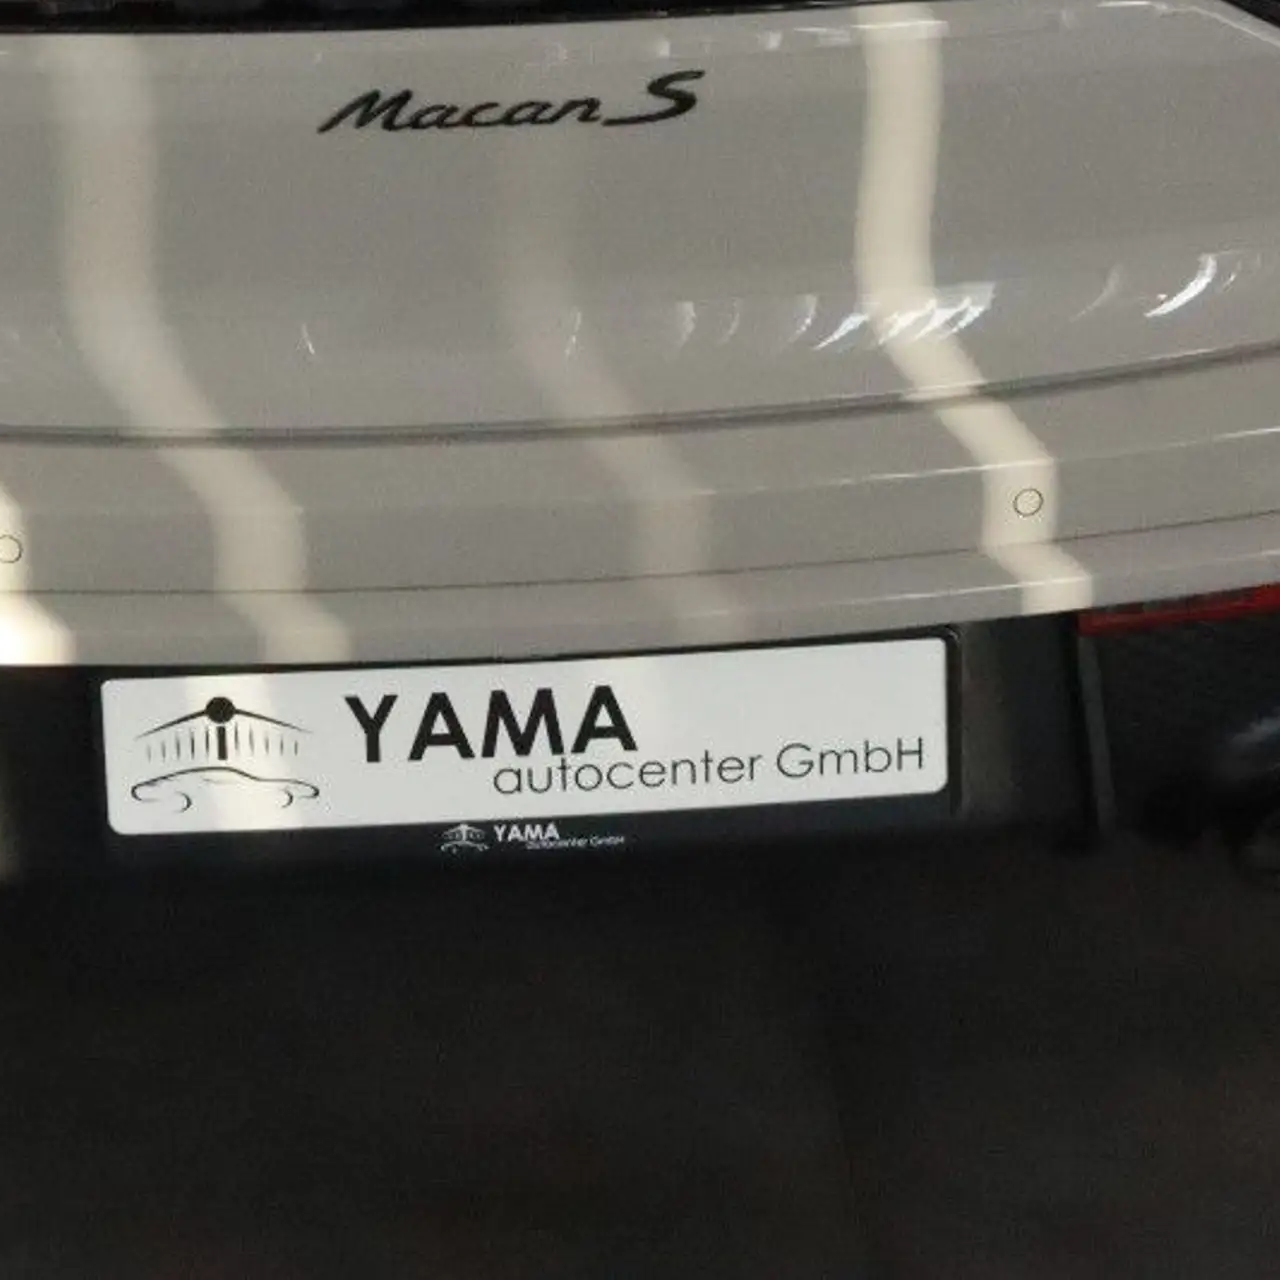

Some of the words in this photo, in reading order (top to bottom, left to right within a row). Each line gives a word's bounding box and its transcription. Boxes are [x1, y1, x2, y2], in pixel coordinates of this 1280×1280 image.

[317, 89, 602, 134] Macan
[602, 70, 705, 127] S
[344, 685, 638, 763] YAMA
[493, 749, 763, 795] autocenter
[776, 737, 924, 779] GmbH
[493, 823, 560, 842] YAMA
